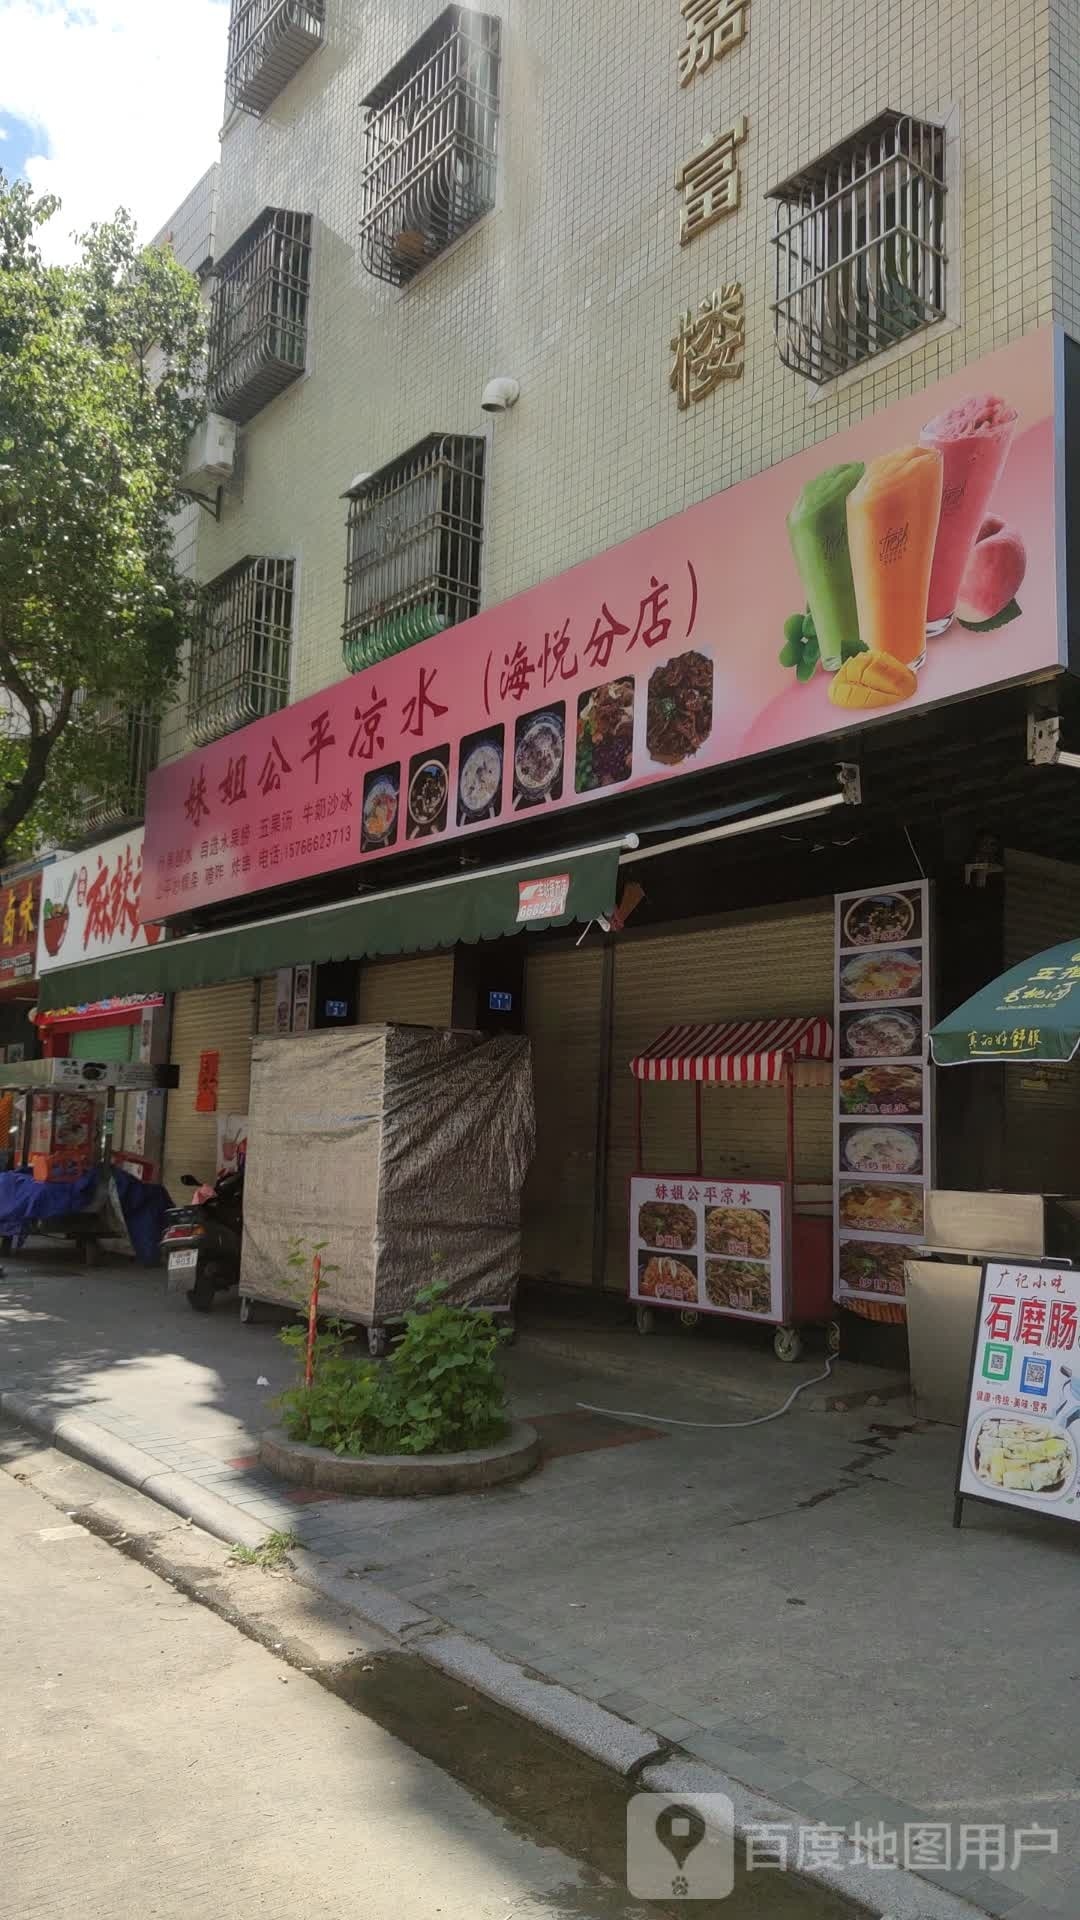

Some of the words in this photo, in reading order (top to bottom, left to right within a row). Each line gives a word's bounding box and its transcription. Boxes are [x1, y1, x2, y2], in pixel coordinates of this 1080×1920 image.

[483, 560, 698, 714] （海悦分店）
[84, 843, 145, 952] 麻辣
[997, 1268, 1066, 1293] 广记小吃
